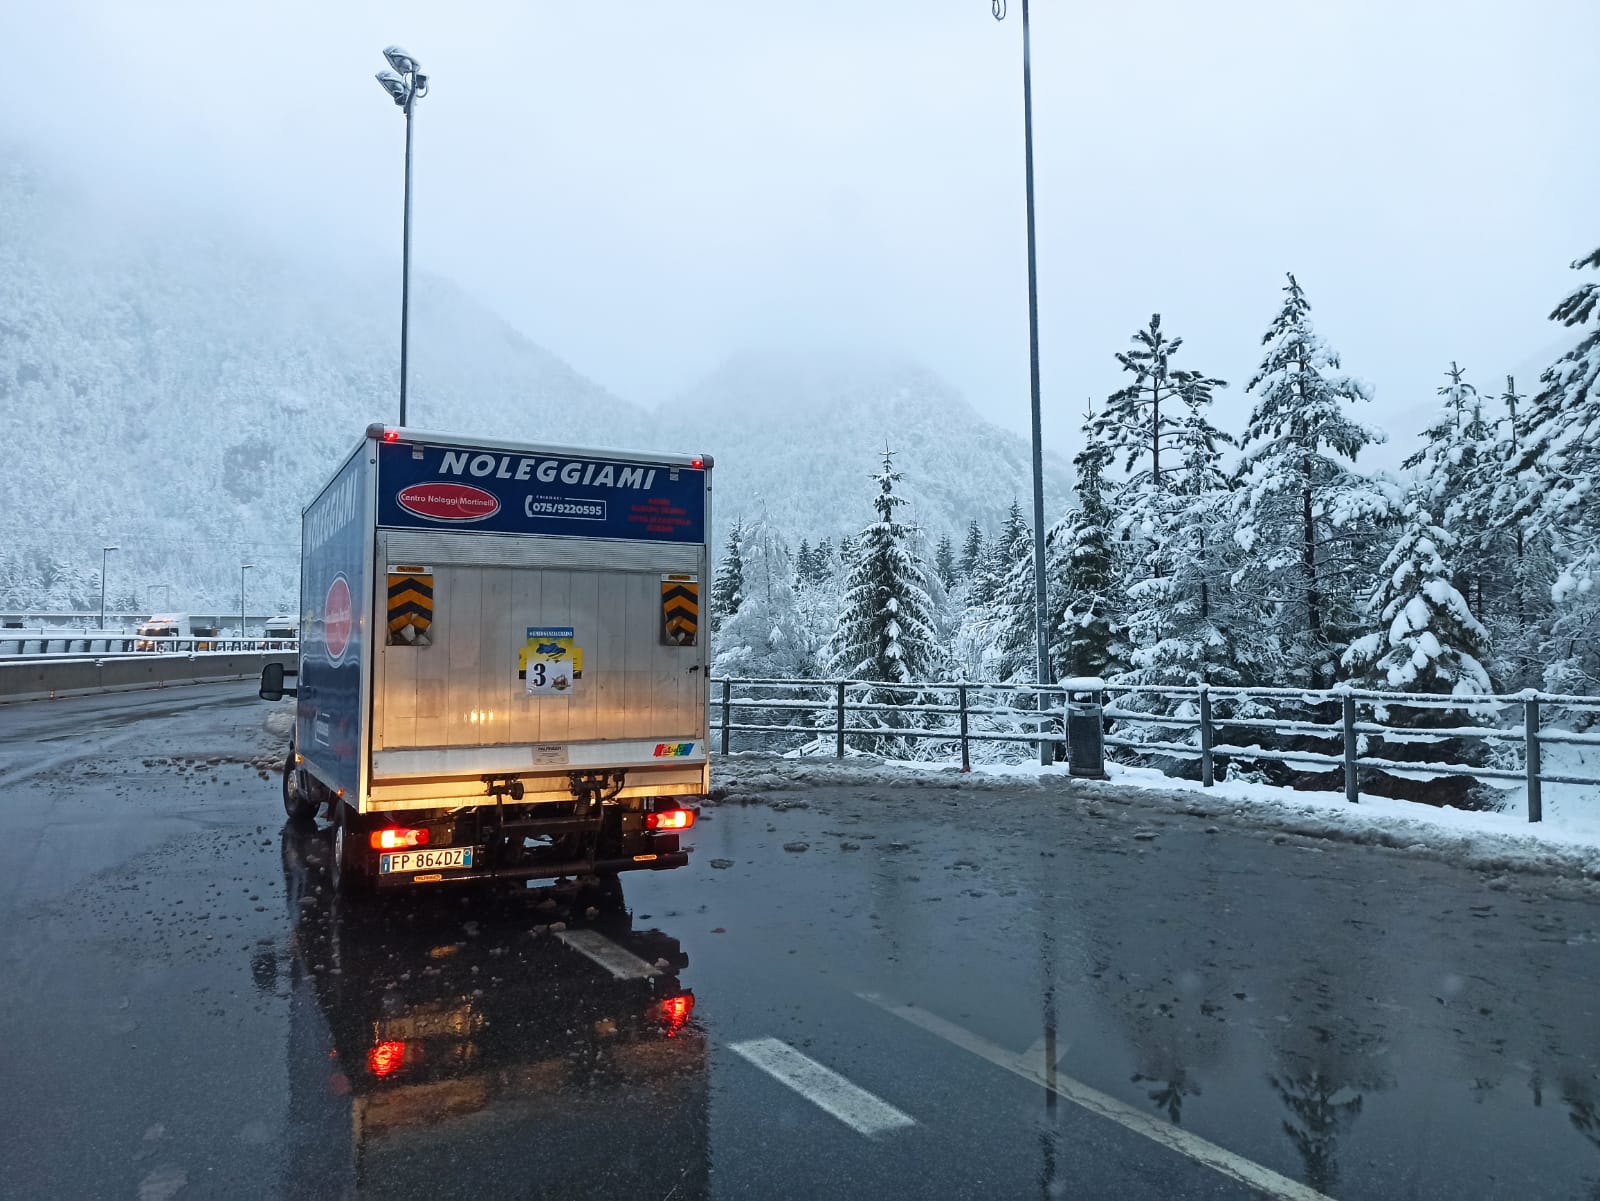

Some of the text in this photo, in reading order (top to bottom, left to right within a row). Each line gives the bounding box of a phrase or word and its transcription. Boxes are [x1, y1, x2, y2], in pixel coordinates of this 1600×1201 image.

[438, 451, 656, 490] NOLEGGIAMI
[400, 493, 494, 507] Centro Noleggi Martinelli
[532, 502, 602, 516] 075/9220595
[533, 663, 547, 687] 3
[391, 850, 462, 871] FP 864DZ
